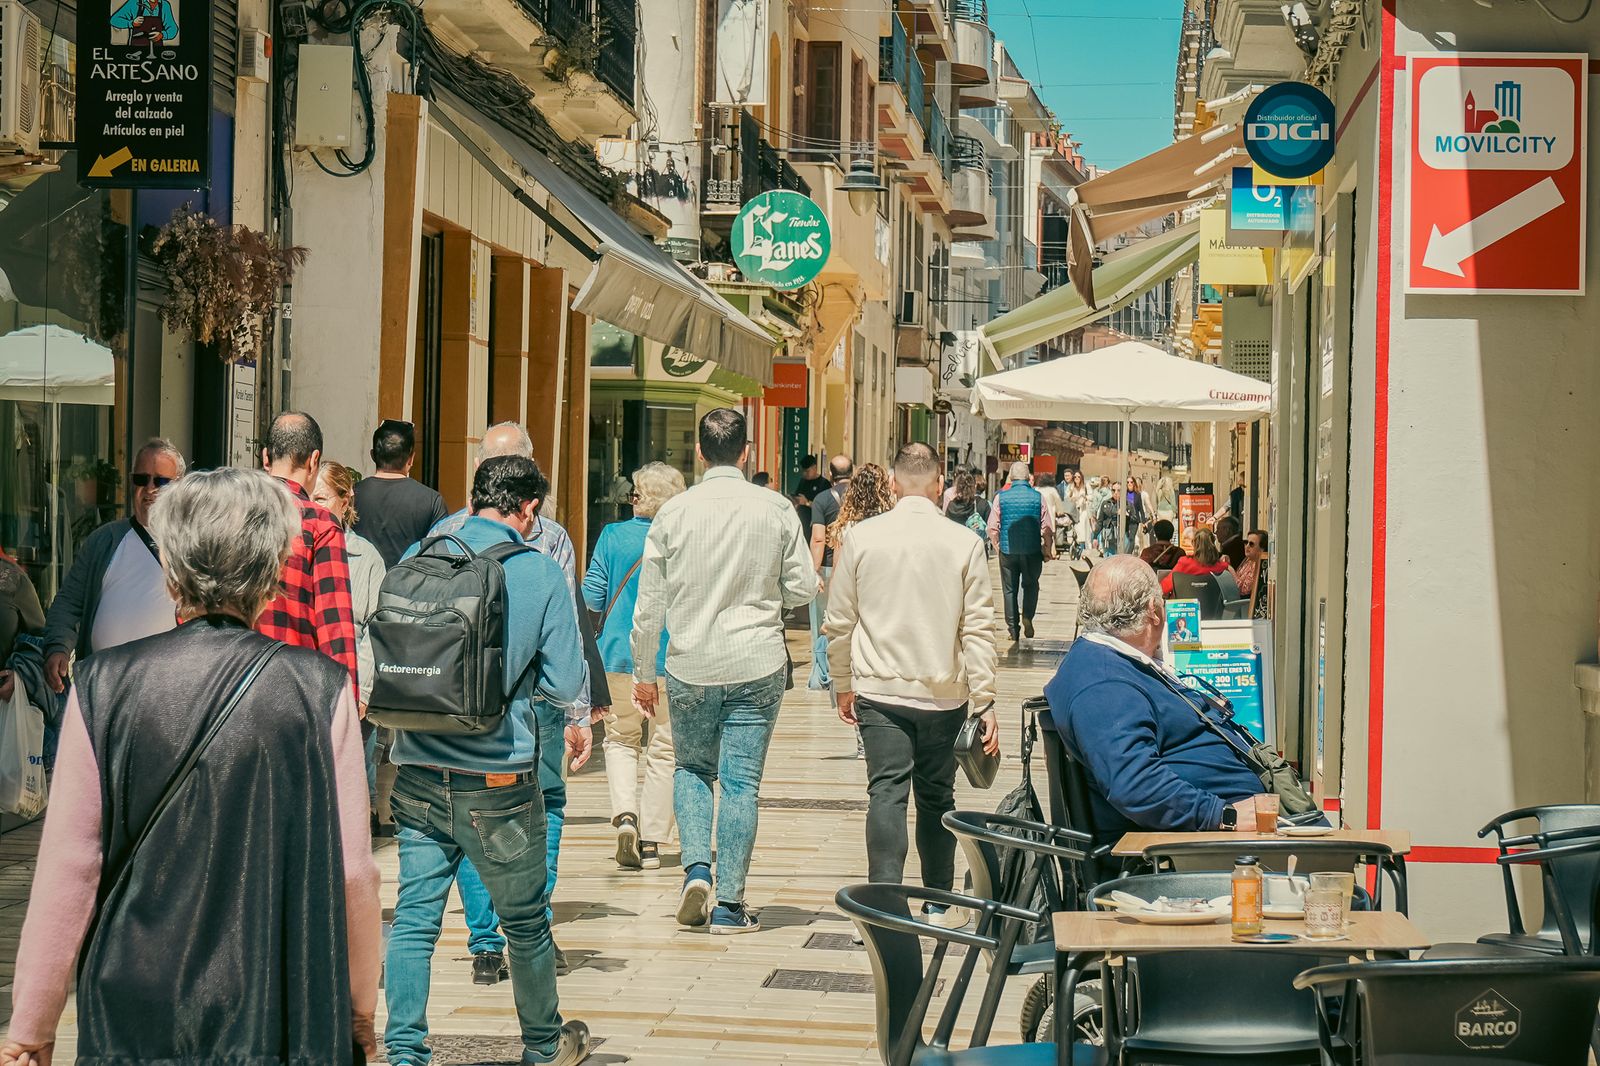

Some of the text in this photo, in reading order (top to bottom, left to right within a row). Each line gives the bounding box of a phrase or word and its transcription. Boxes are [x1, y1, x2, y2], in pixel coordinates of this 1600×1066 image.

[93, 47, 114, 61] EL
[90, 61, 199, 83] ARTESANO
[105, 90, 183, 105] Arreglo y venta
[115, 106, 173, 120] del calzado
[103, 124, 185, 138] Artículos en piel
[1247, 123, 1330, 141] DIGI
[1435, 136, 1556, 153] MOVILCITY
[131, 158, 200, 173] EN GALERIA
[773, 382, 802, 390] ankinter
[1208, 388, 1272, 404] Cruzcampo
[793, 407, 801, 473] rbolario
[379, 662, 441, 677] factorenergia
[1458, 1020, 1517, 1036] BARCO
